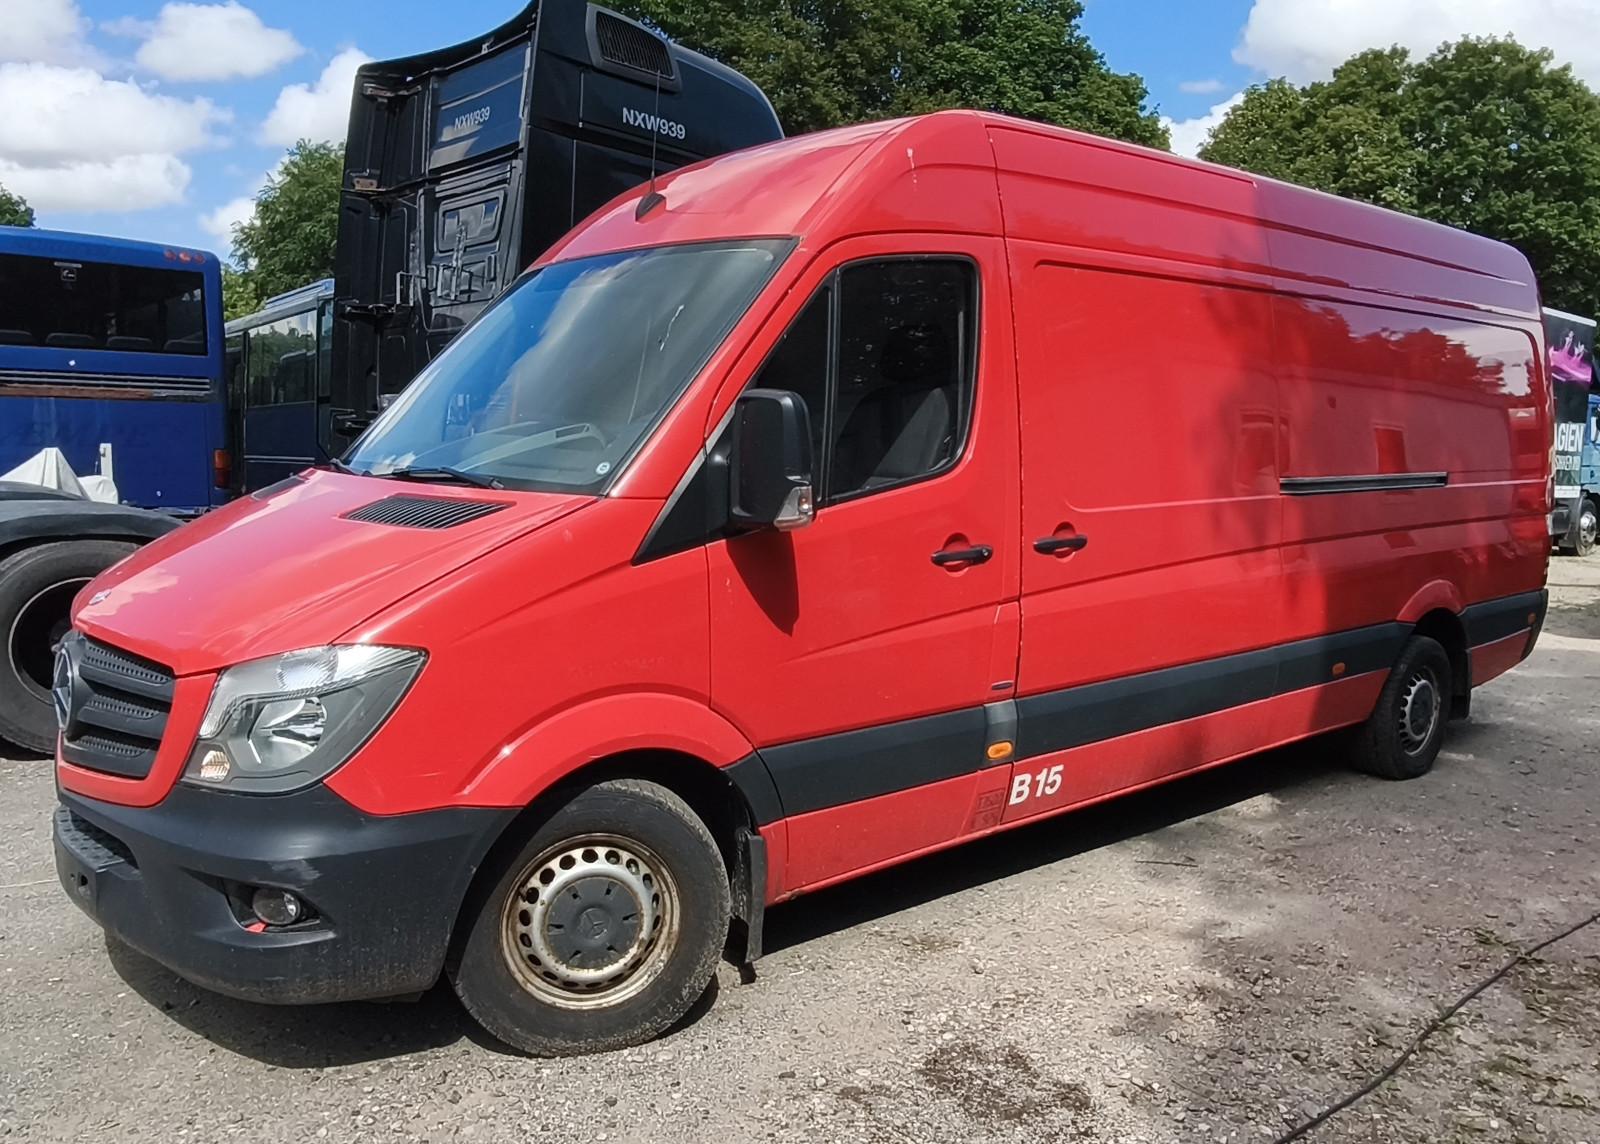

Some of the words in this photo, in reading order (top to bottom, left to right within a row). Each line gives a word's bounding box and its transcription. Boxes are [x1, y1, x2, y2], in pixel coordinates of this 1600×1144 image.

[454, 105, 491, 131] NXW939
[622, 107, 686, 140] NXW939
[1555, 423, 1585, 453] GIEN
[1008, 773, 1032, 805] B
[1035, 764, 1064, 797] 15
